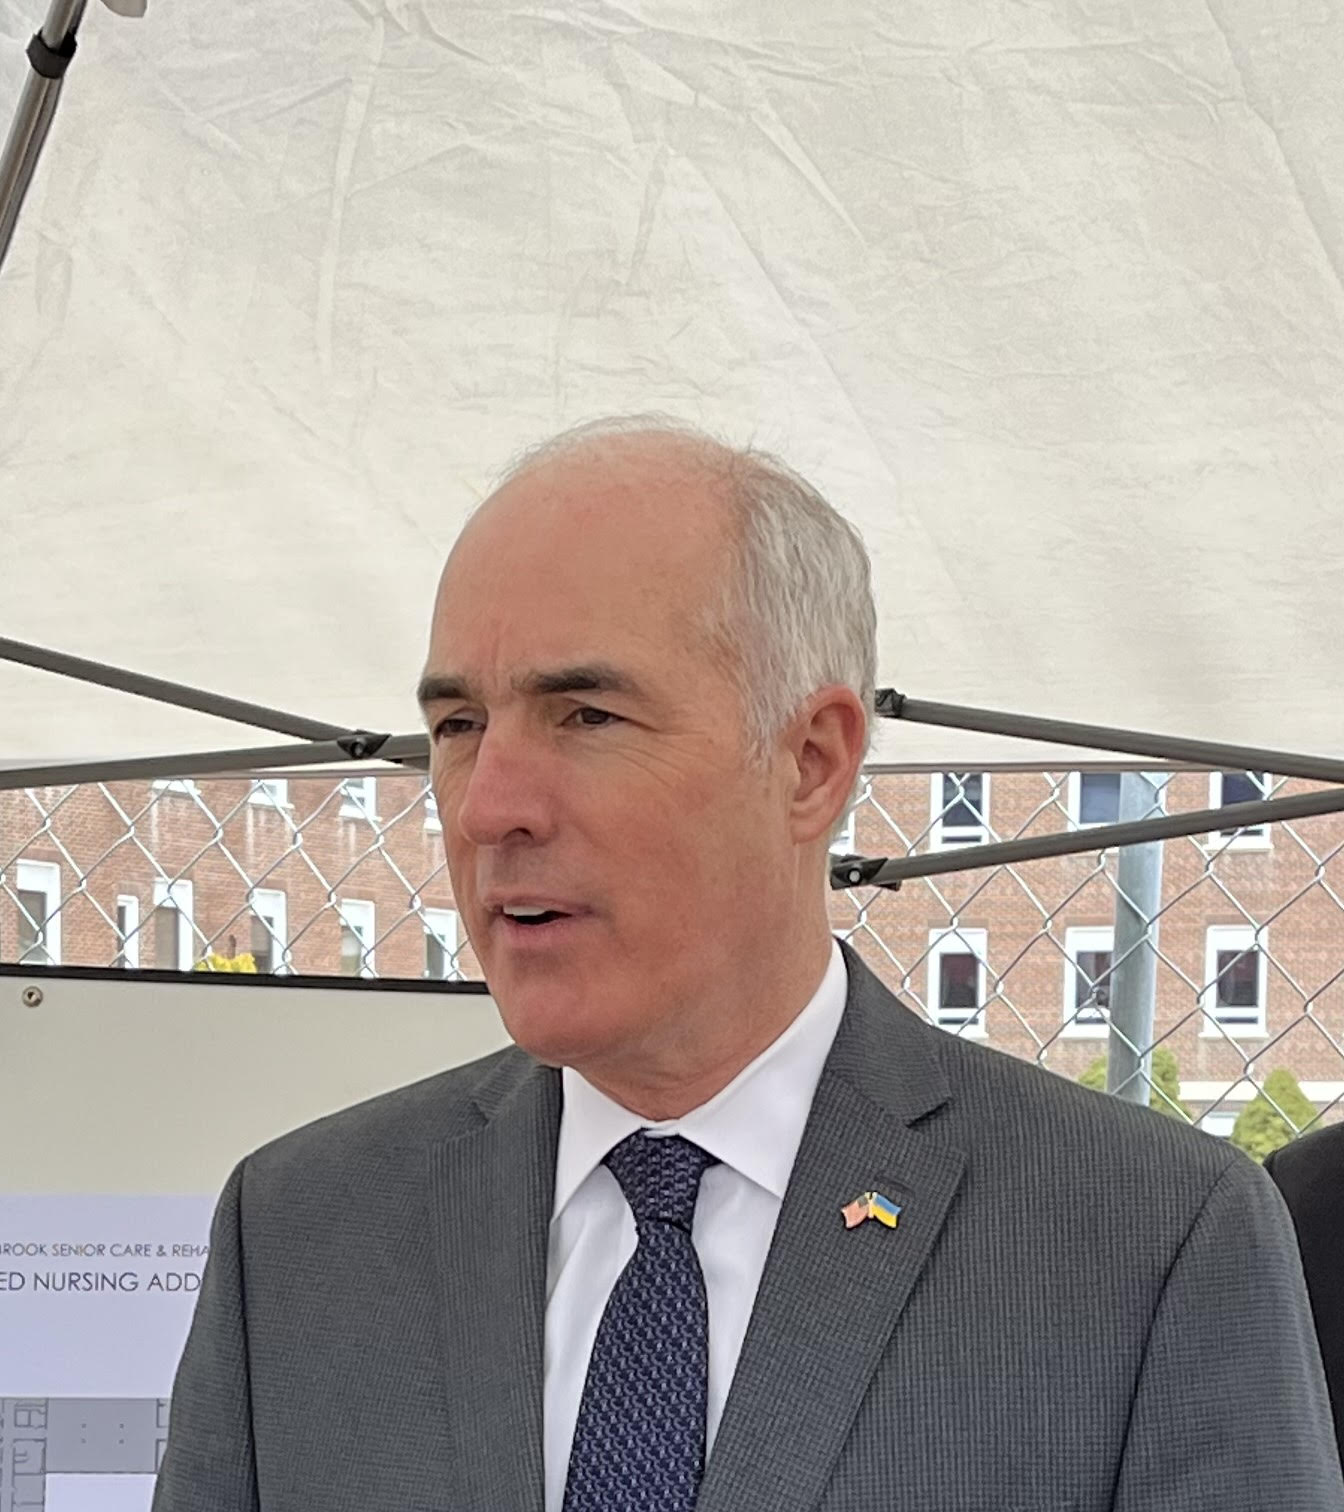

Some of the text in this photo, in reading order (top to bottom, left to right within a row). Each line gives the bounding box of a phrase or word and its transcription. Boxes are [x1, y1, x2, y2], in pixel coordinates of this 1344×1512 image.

[52, 1243, 105, 1257] SENIOR
[110, 1243, 152, 1257] CARE
[156, 1244, 166, 1257] &
[33, 1271, 139, 1292] NURSING
[147, 1272, 201, 1292] ADD
